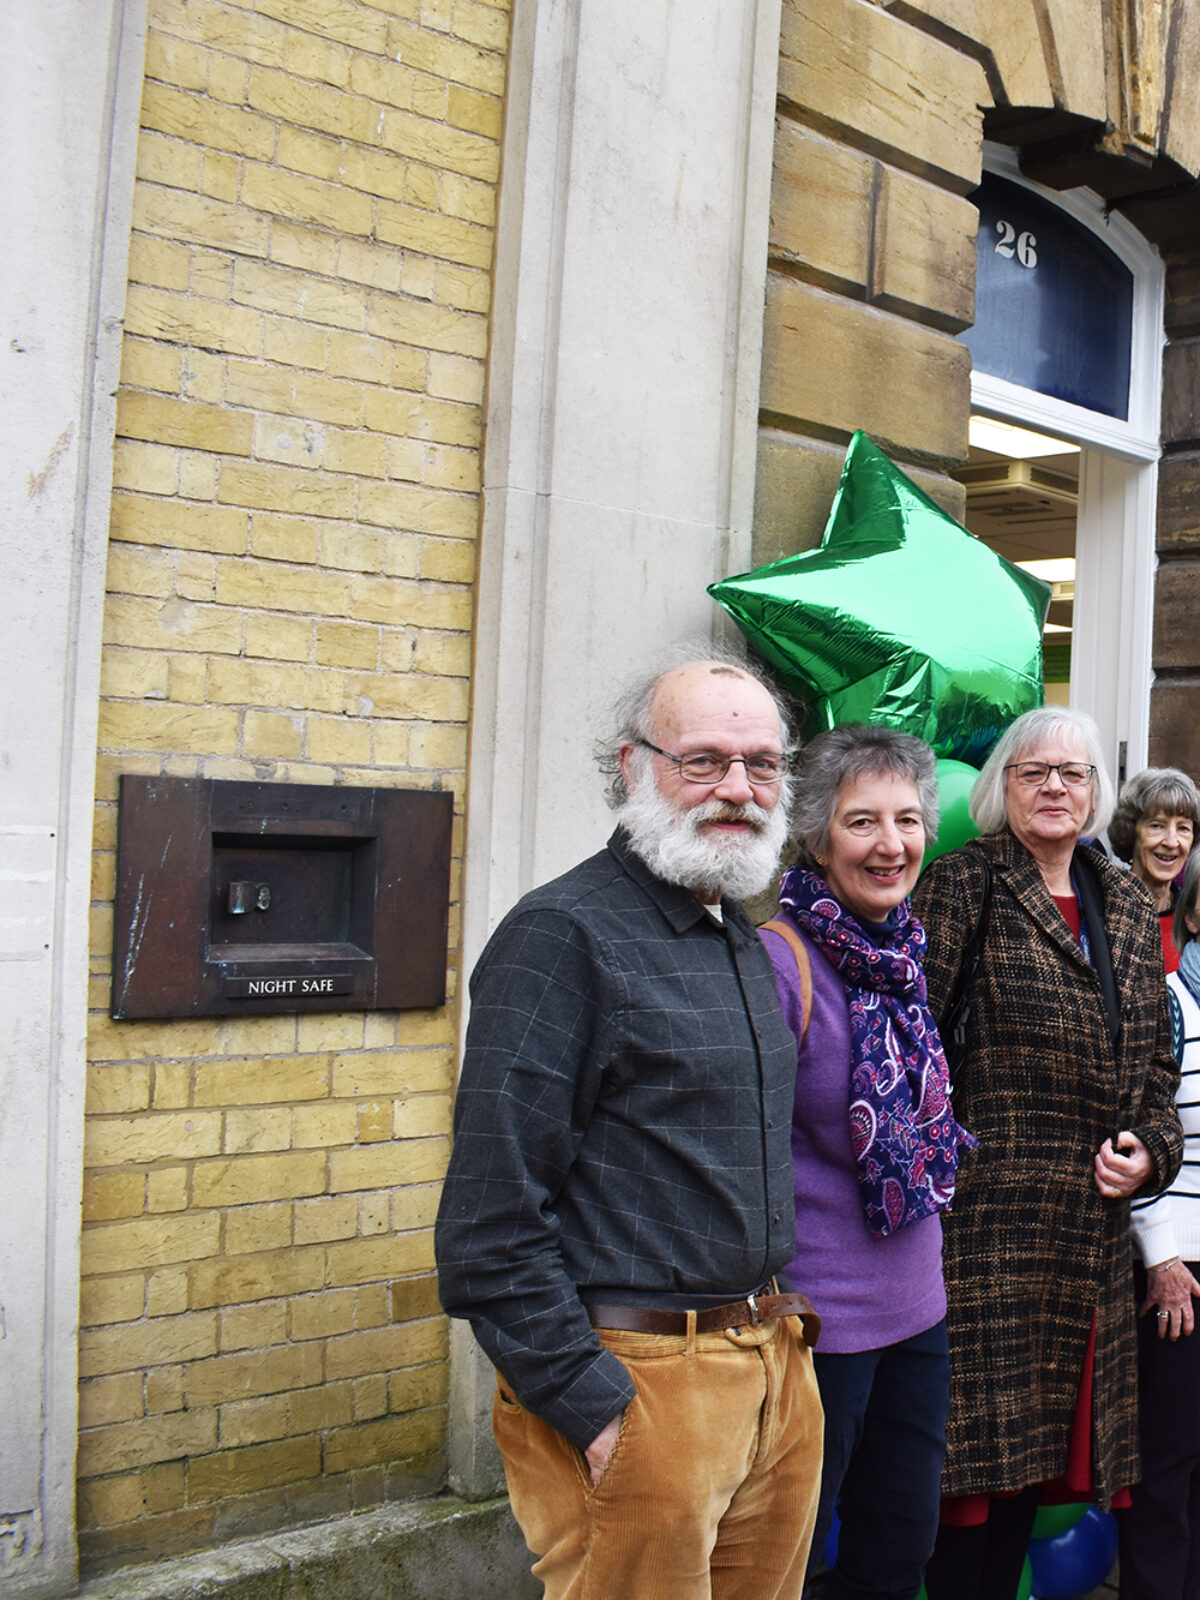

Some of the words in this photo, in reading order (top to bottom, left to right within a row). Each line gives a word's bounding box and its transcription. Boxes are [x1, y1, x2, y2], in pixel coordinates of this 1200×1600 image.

[995, 220, 1037, 269] 26
[248, 980, 296, 994] NIGHT
[302, 979, 334, 992] SAFE
